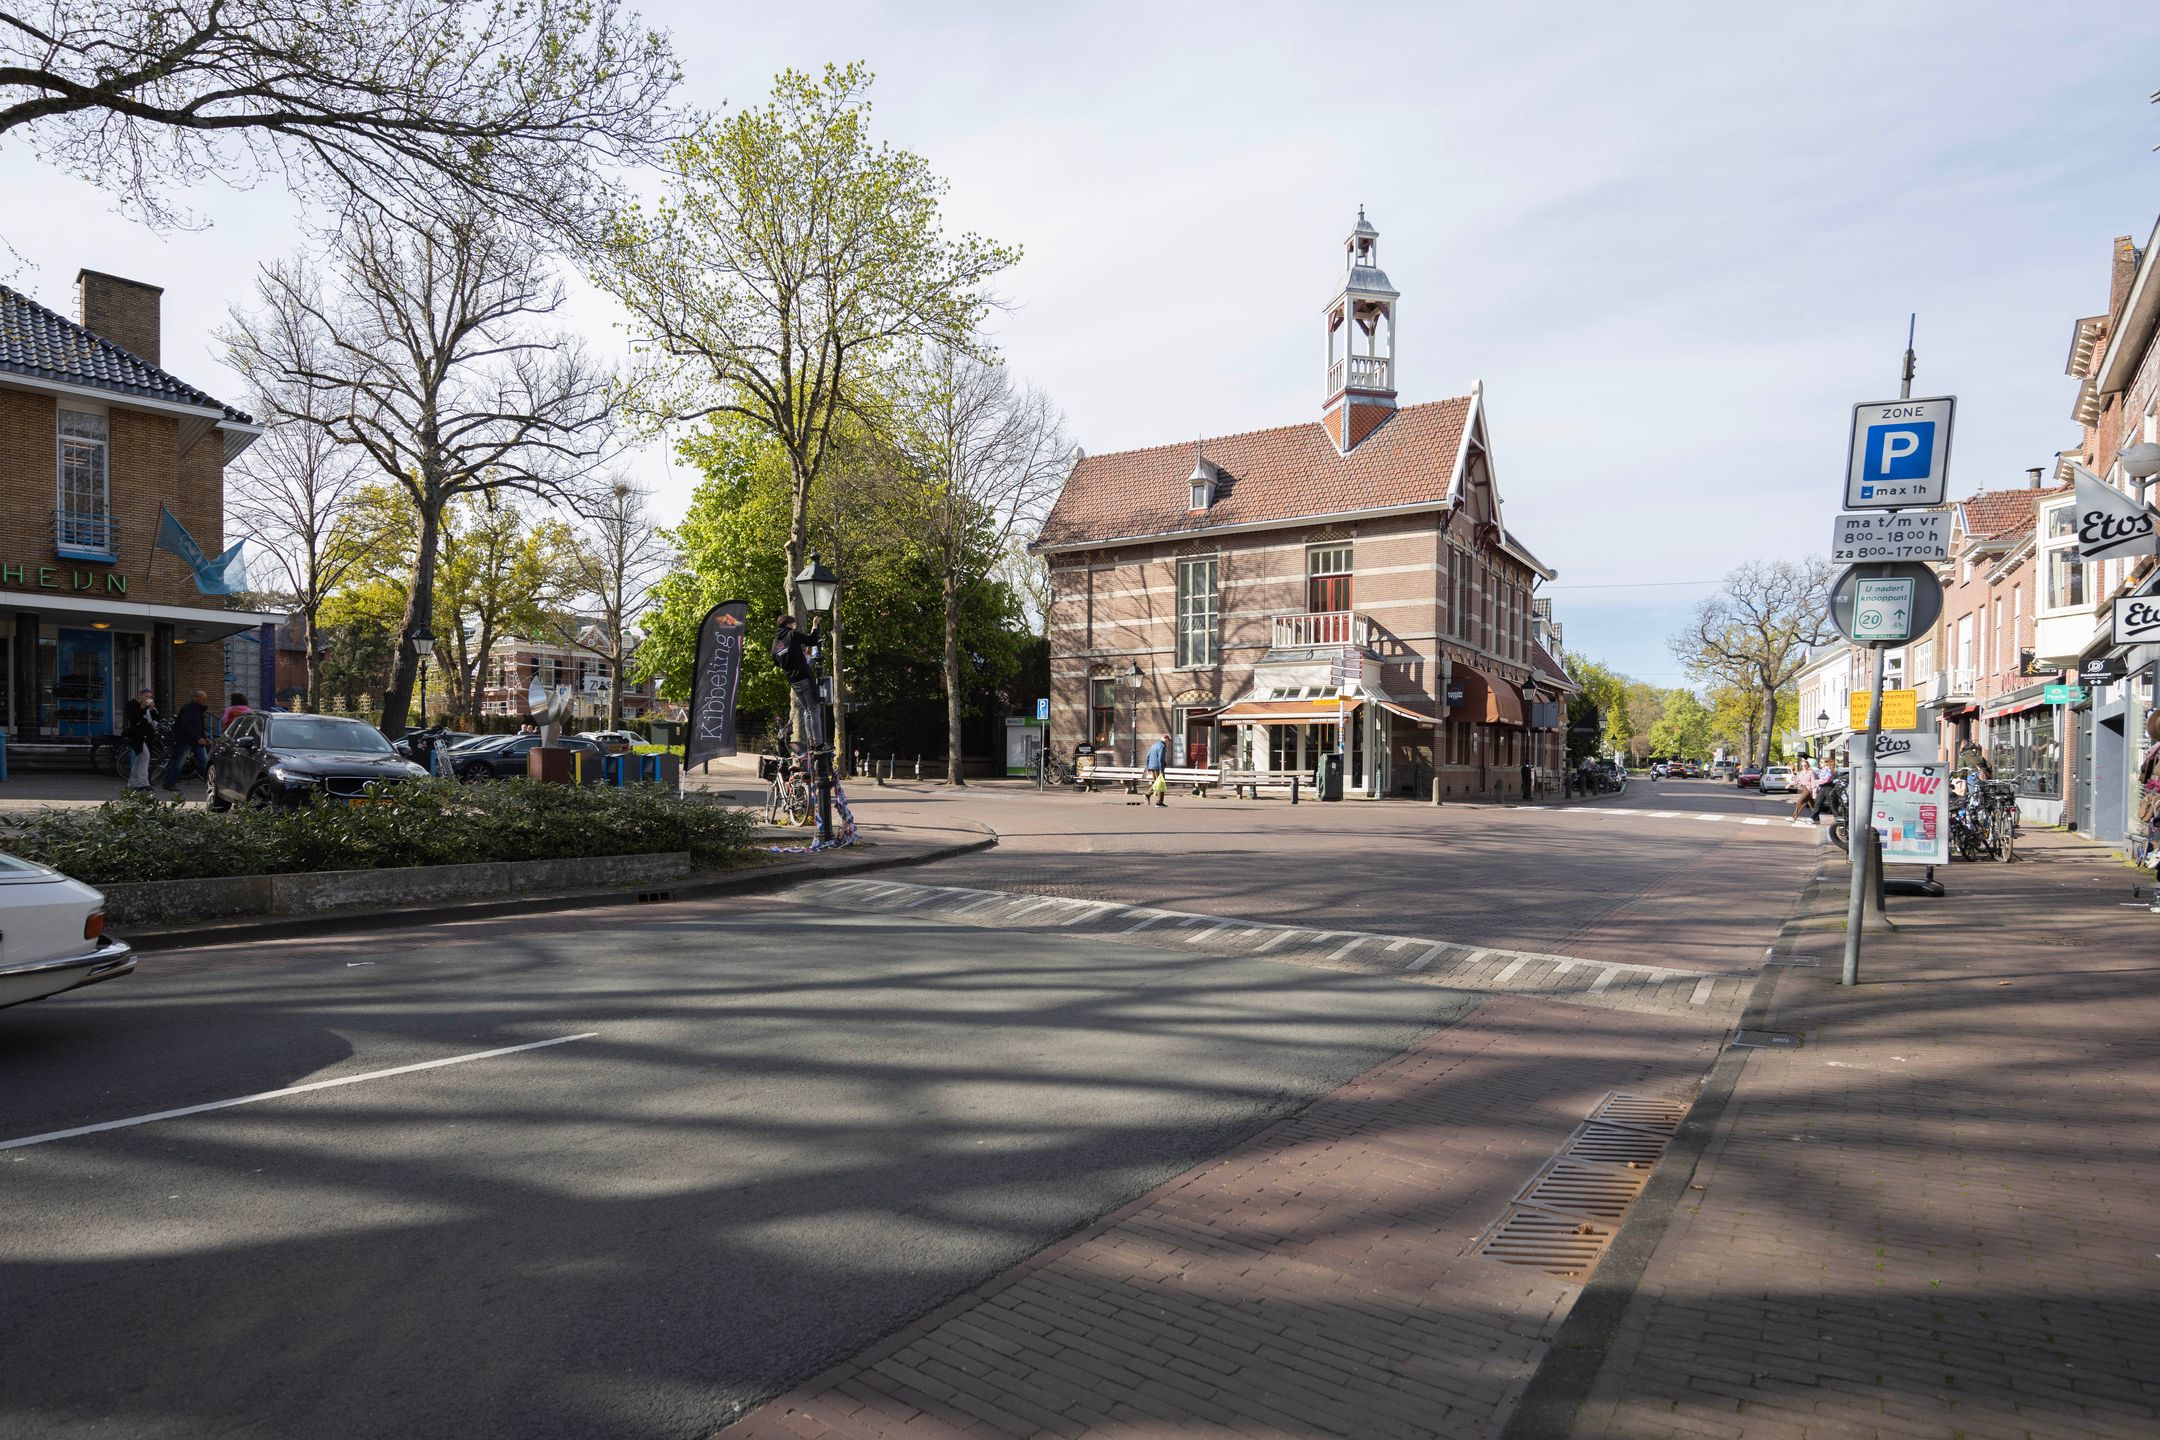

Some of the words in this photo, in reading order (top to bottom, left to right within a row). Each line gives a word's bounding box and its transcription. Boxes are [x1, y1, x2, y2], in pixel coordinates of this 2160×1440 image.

[1881, 406, 1924, 419] ZONE
[1880, 431, 1920, 475] P
[1875, 487, 1907, 496] max
[1912, 484, 1927, 494] 1h
[1846, 519, 1871, 529] ma
[1878, 515, 1912, 528] t/m
[1919, 517, 1939, 526] vr
[2078, 510, 2154, 545] Etos
[1835, 550, 1854, 559] za
[1865, 585, 1872, 593] U
[1860, 594, 1908, 602] knooppunt
[1862, 614, 1880, 625] 20
[700, 631, 735, 742] Kibbeling
[1875, 735, 1911, 753] Etos
